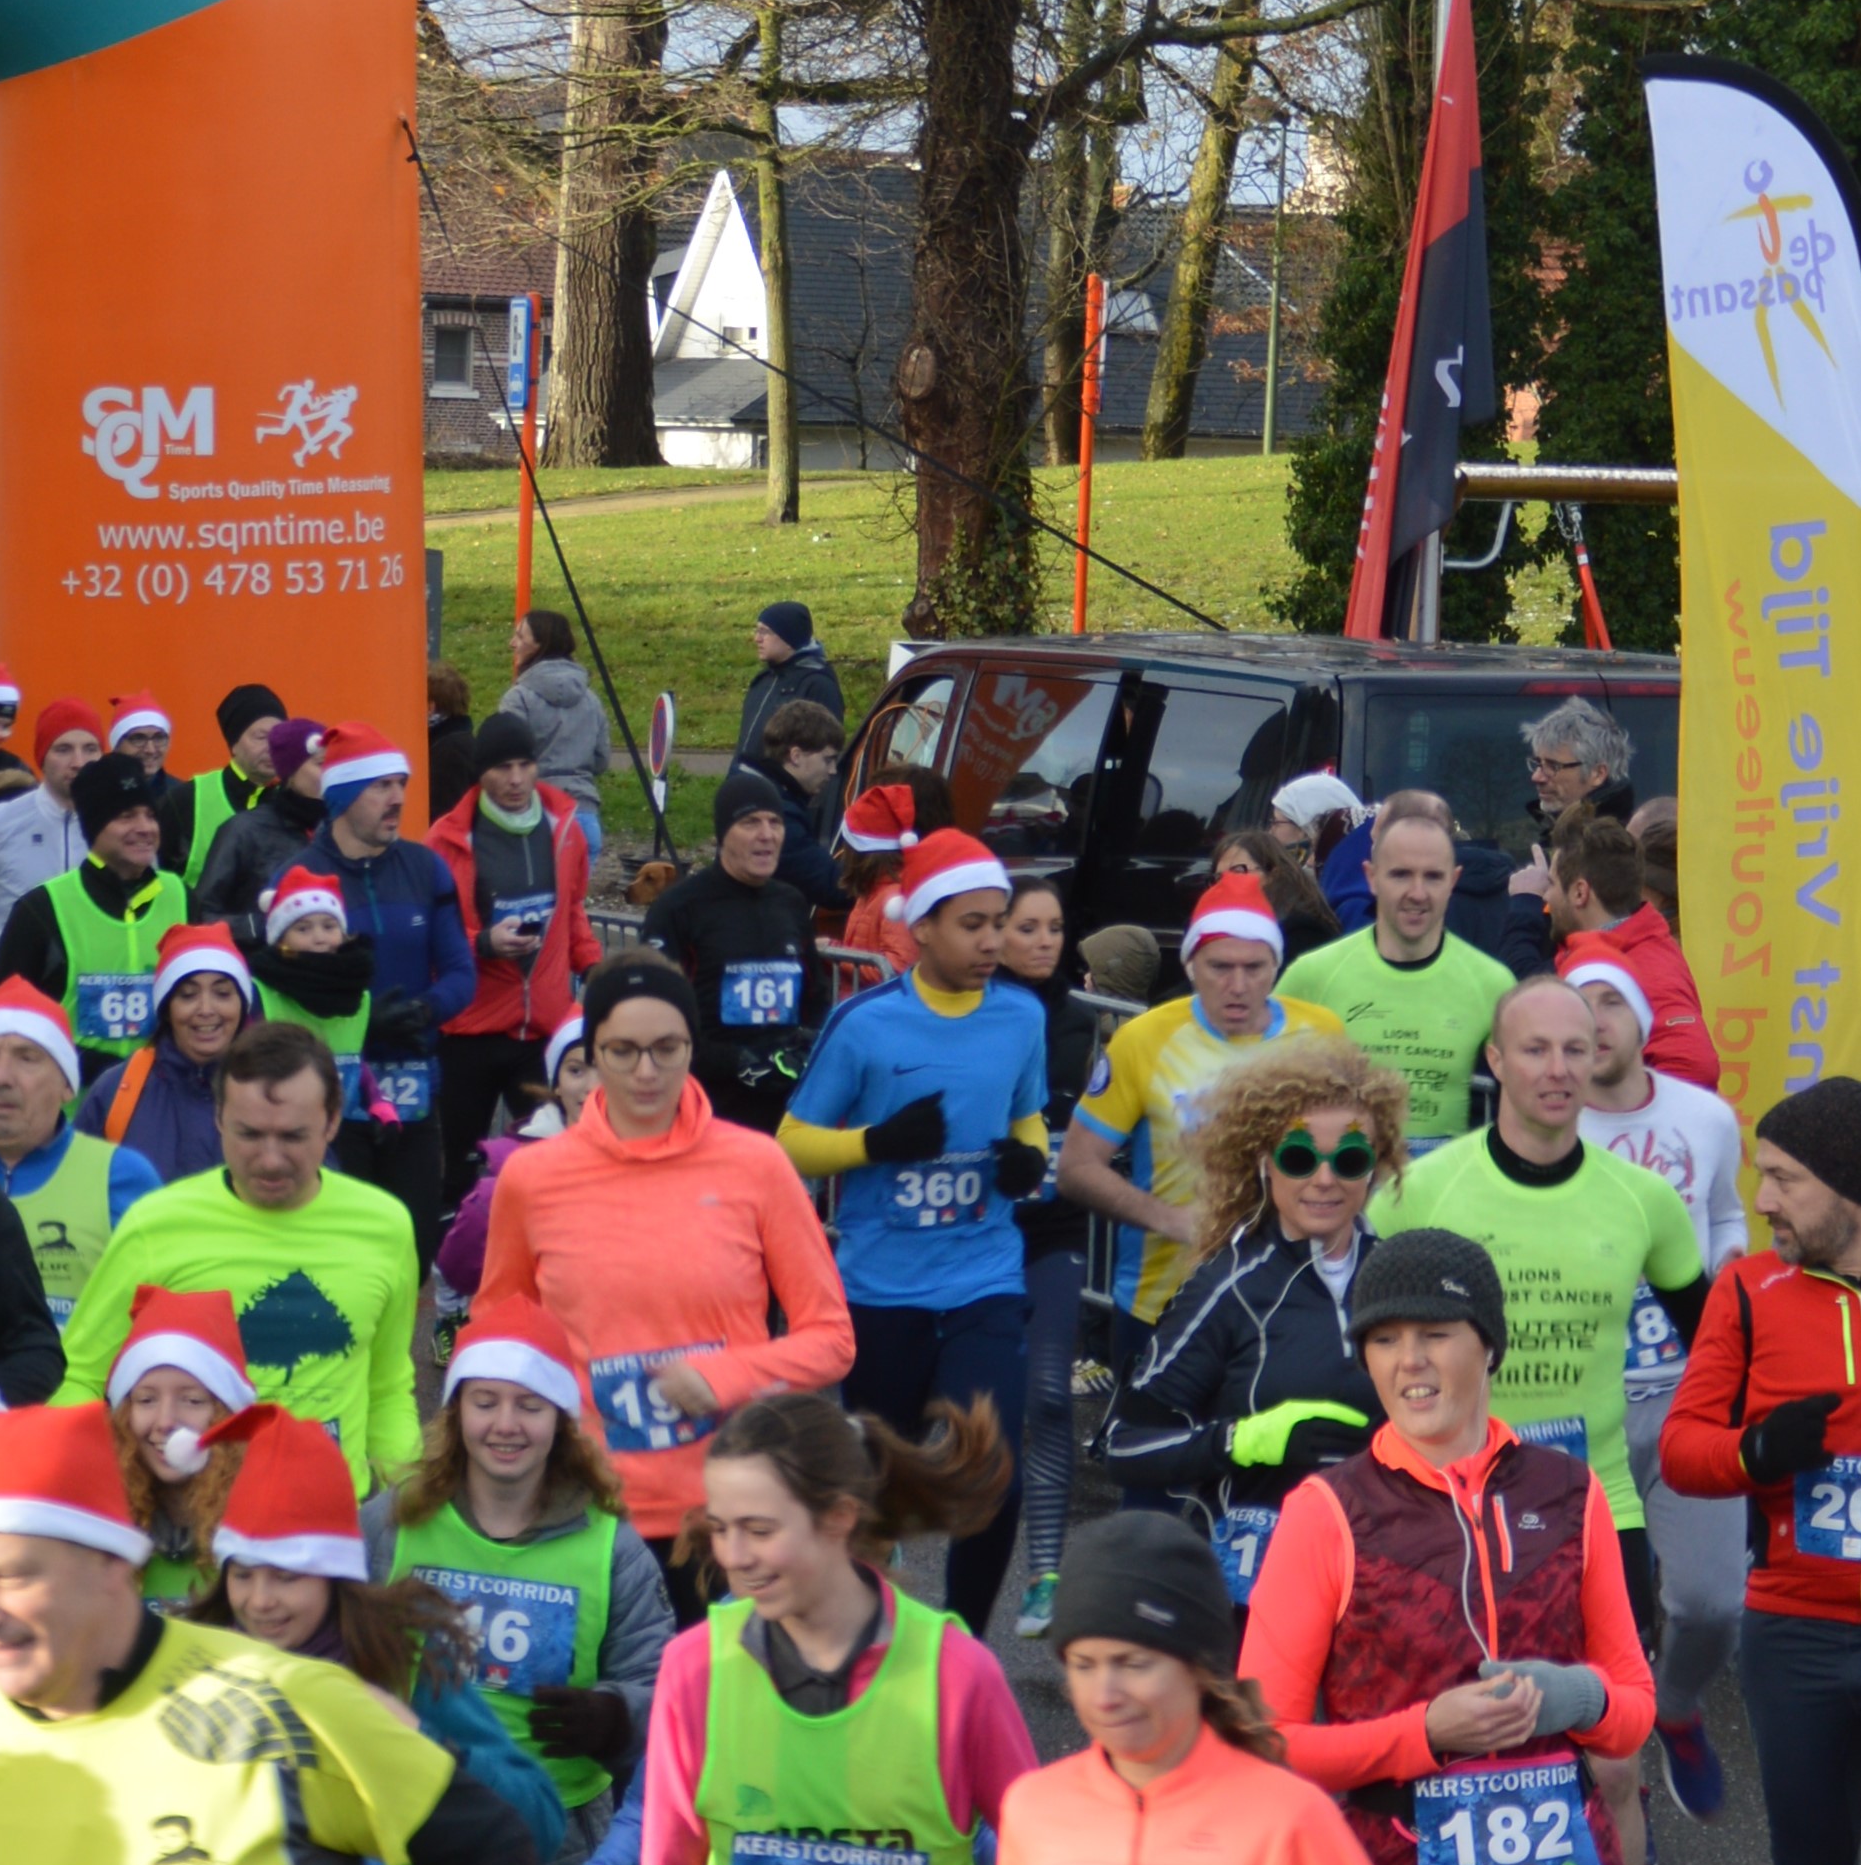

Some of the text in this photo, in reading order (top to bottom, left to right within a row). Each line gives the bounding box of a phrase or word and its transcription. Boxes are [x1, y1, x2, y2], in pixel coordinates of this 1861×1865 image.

[164, 443, 192, 456] Time
[168, 475, 392, 502] Sports Quality Time Measuring
[98, 511, 386, 556] www.sqmtime.be
[61, 554, 404, 605] +32 (0) 478 53 71 26
[100, 991, 148, 1022] 68
[734, 978, 794, 1008] 161
[894, 1171, 981, 1208] 360
[1508, 1270, 1562, 1283] LIONS
[1540, 1290, 1613, 1307] CANCER
[412, 1565, 576, 1607] KERSTCORRIDA
[1414, 1763, 1577, 1799] KERSTCORRIDA
